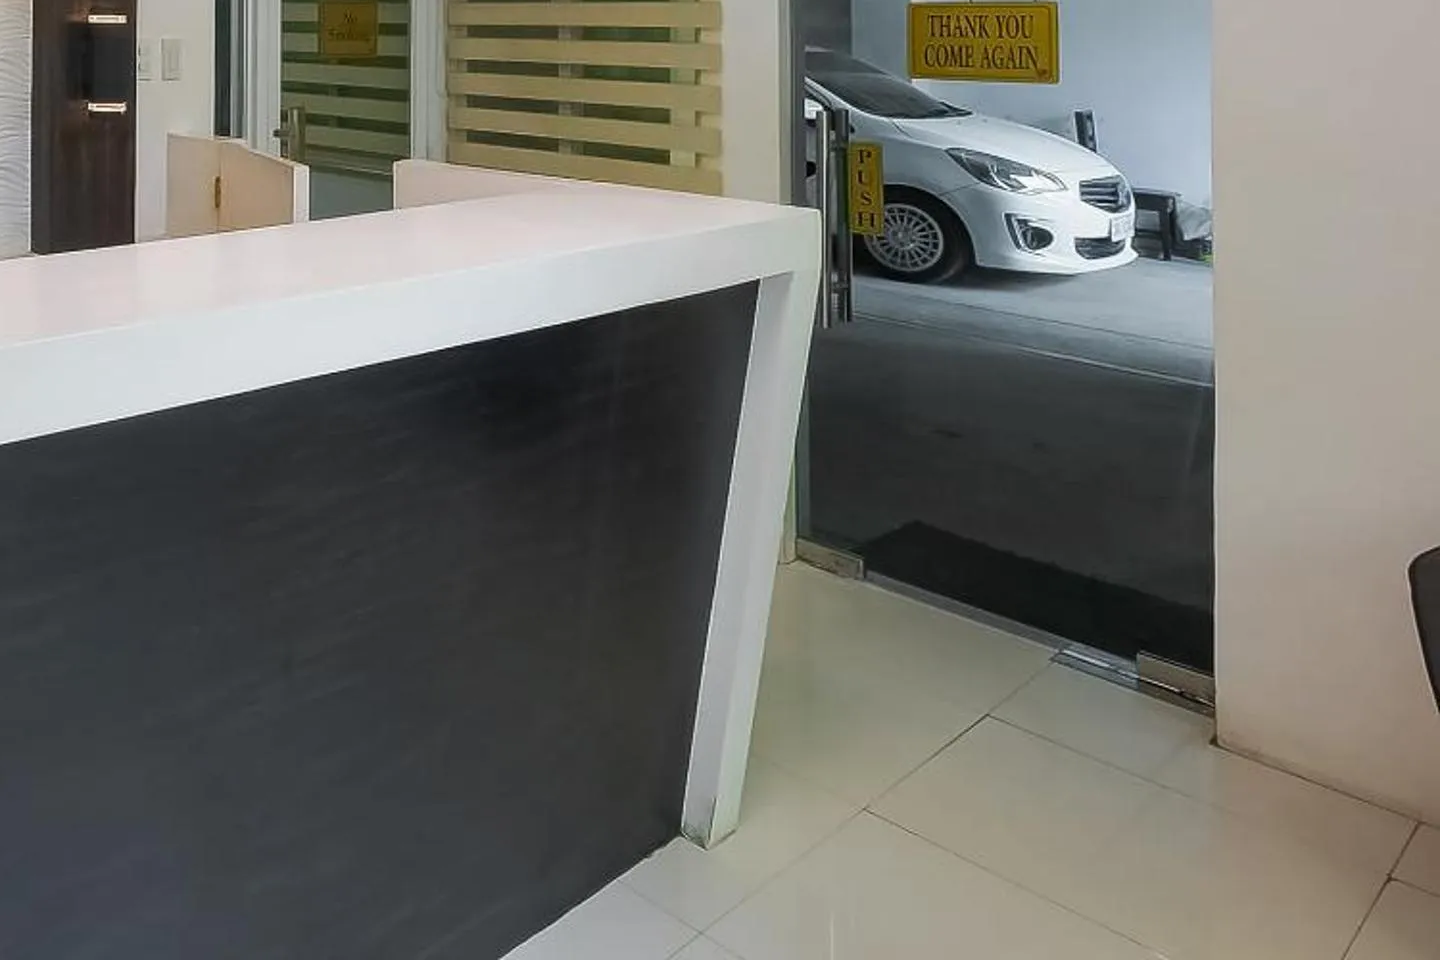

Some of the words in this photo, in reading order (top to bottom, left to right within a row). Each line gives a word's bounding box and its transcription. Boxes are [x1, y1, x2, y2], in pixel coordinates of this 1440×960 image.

[927, 14, 990, 39] THANK
[994, 14, 1034, 39] YOU
[924, 43, 974, 68] COME
[980, 45, 1039, 70] AGAIN
[856, 149, 876, 228] PUSH
